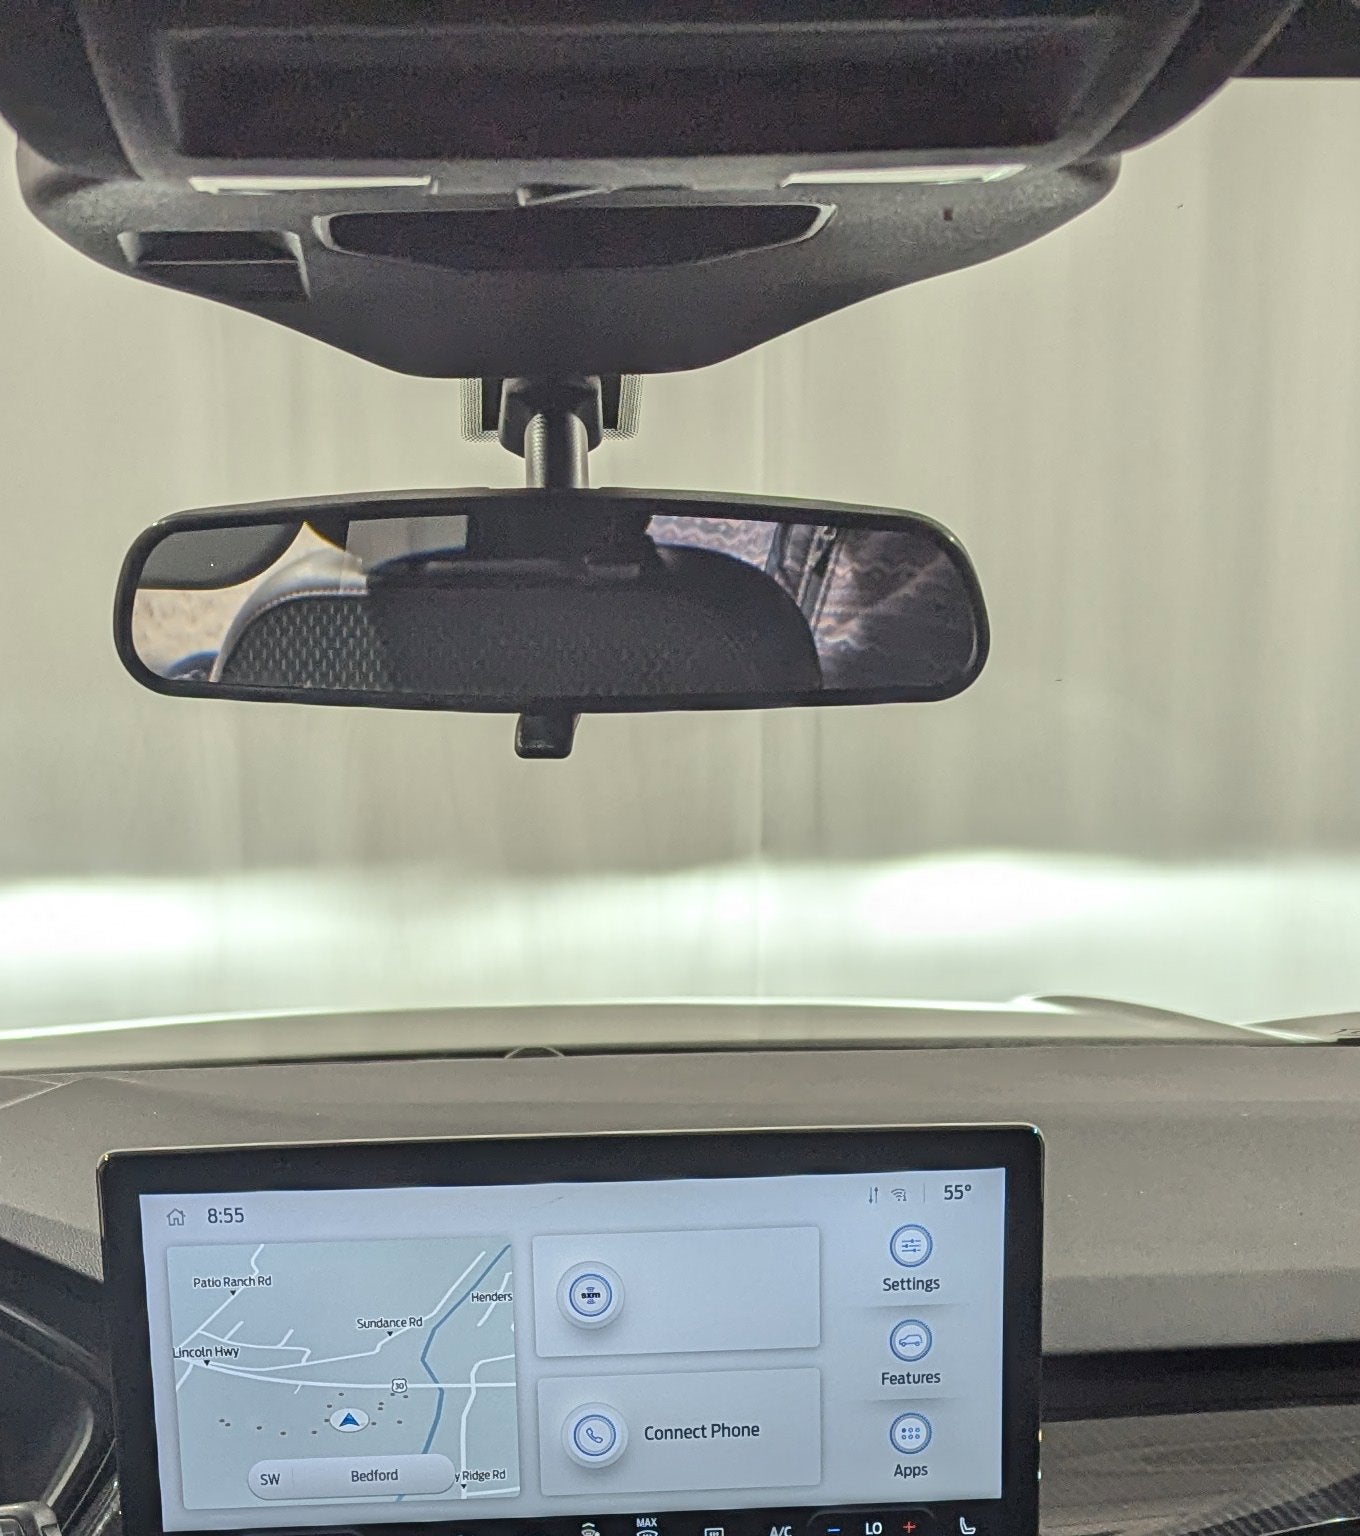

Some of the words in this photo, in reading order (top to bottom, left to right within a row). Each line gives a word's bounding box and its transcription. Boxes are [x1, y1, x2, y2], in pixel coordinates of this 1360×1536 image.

[942, 1183, 972, 1201] 55°
[206, 1207, 246, 1225] 8:55
[192, 1276, 221, 1289] Patio
[223, 1275, 255, 1288] Ranch
[257, 1275, 273, 1288] Rd
[881, 1275, 941, 1292] Settings
[470, 1291, 513, 1303] Henders
[356, 1316, 406, 1330] Sundance
[408, 1316, 423, 1329] Rd
[172, 1346, 212, 1360] Lincoln
[215, 1345, 240, 1360] Hwy
[880, 1369, 941, 1386] Features
[643, 1422, 708, 1441] Connect
[710, 1421, 761, 1439] Phone
[350, 1468, 399, 1483] Bedford
[462, 1468, 489, 1484] Ridge
[491, 1467, 506, 1481] Rd
[893, 1462, 929, 1480] Apps
[260, 1473, 281, 1487] SW
[636, 1516, 657, 1528] MAX
[864, 1520, 883, 1536] LO
